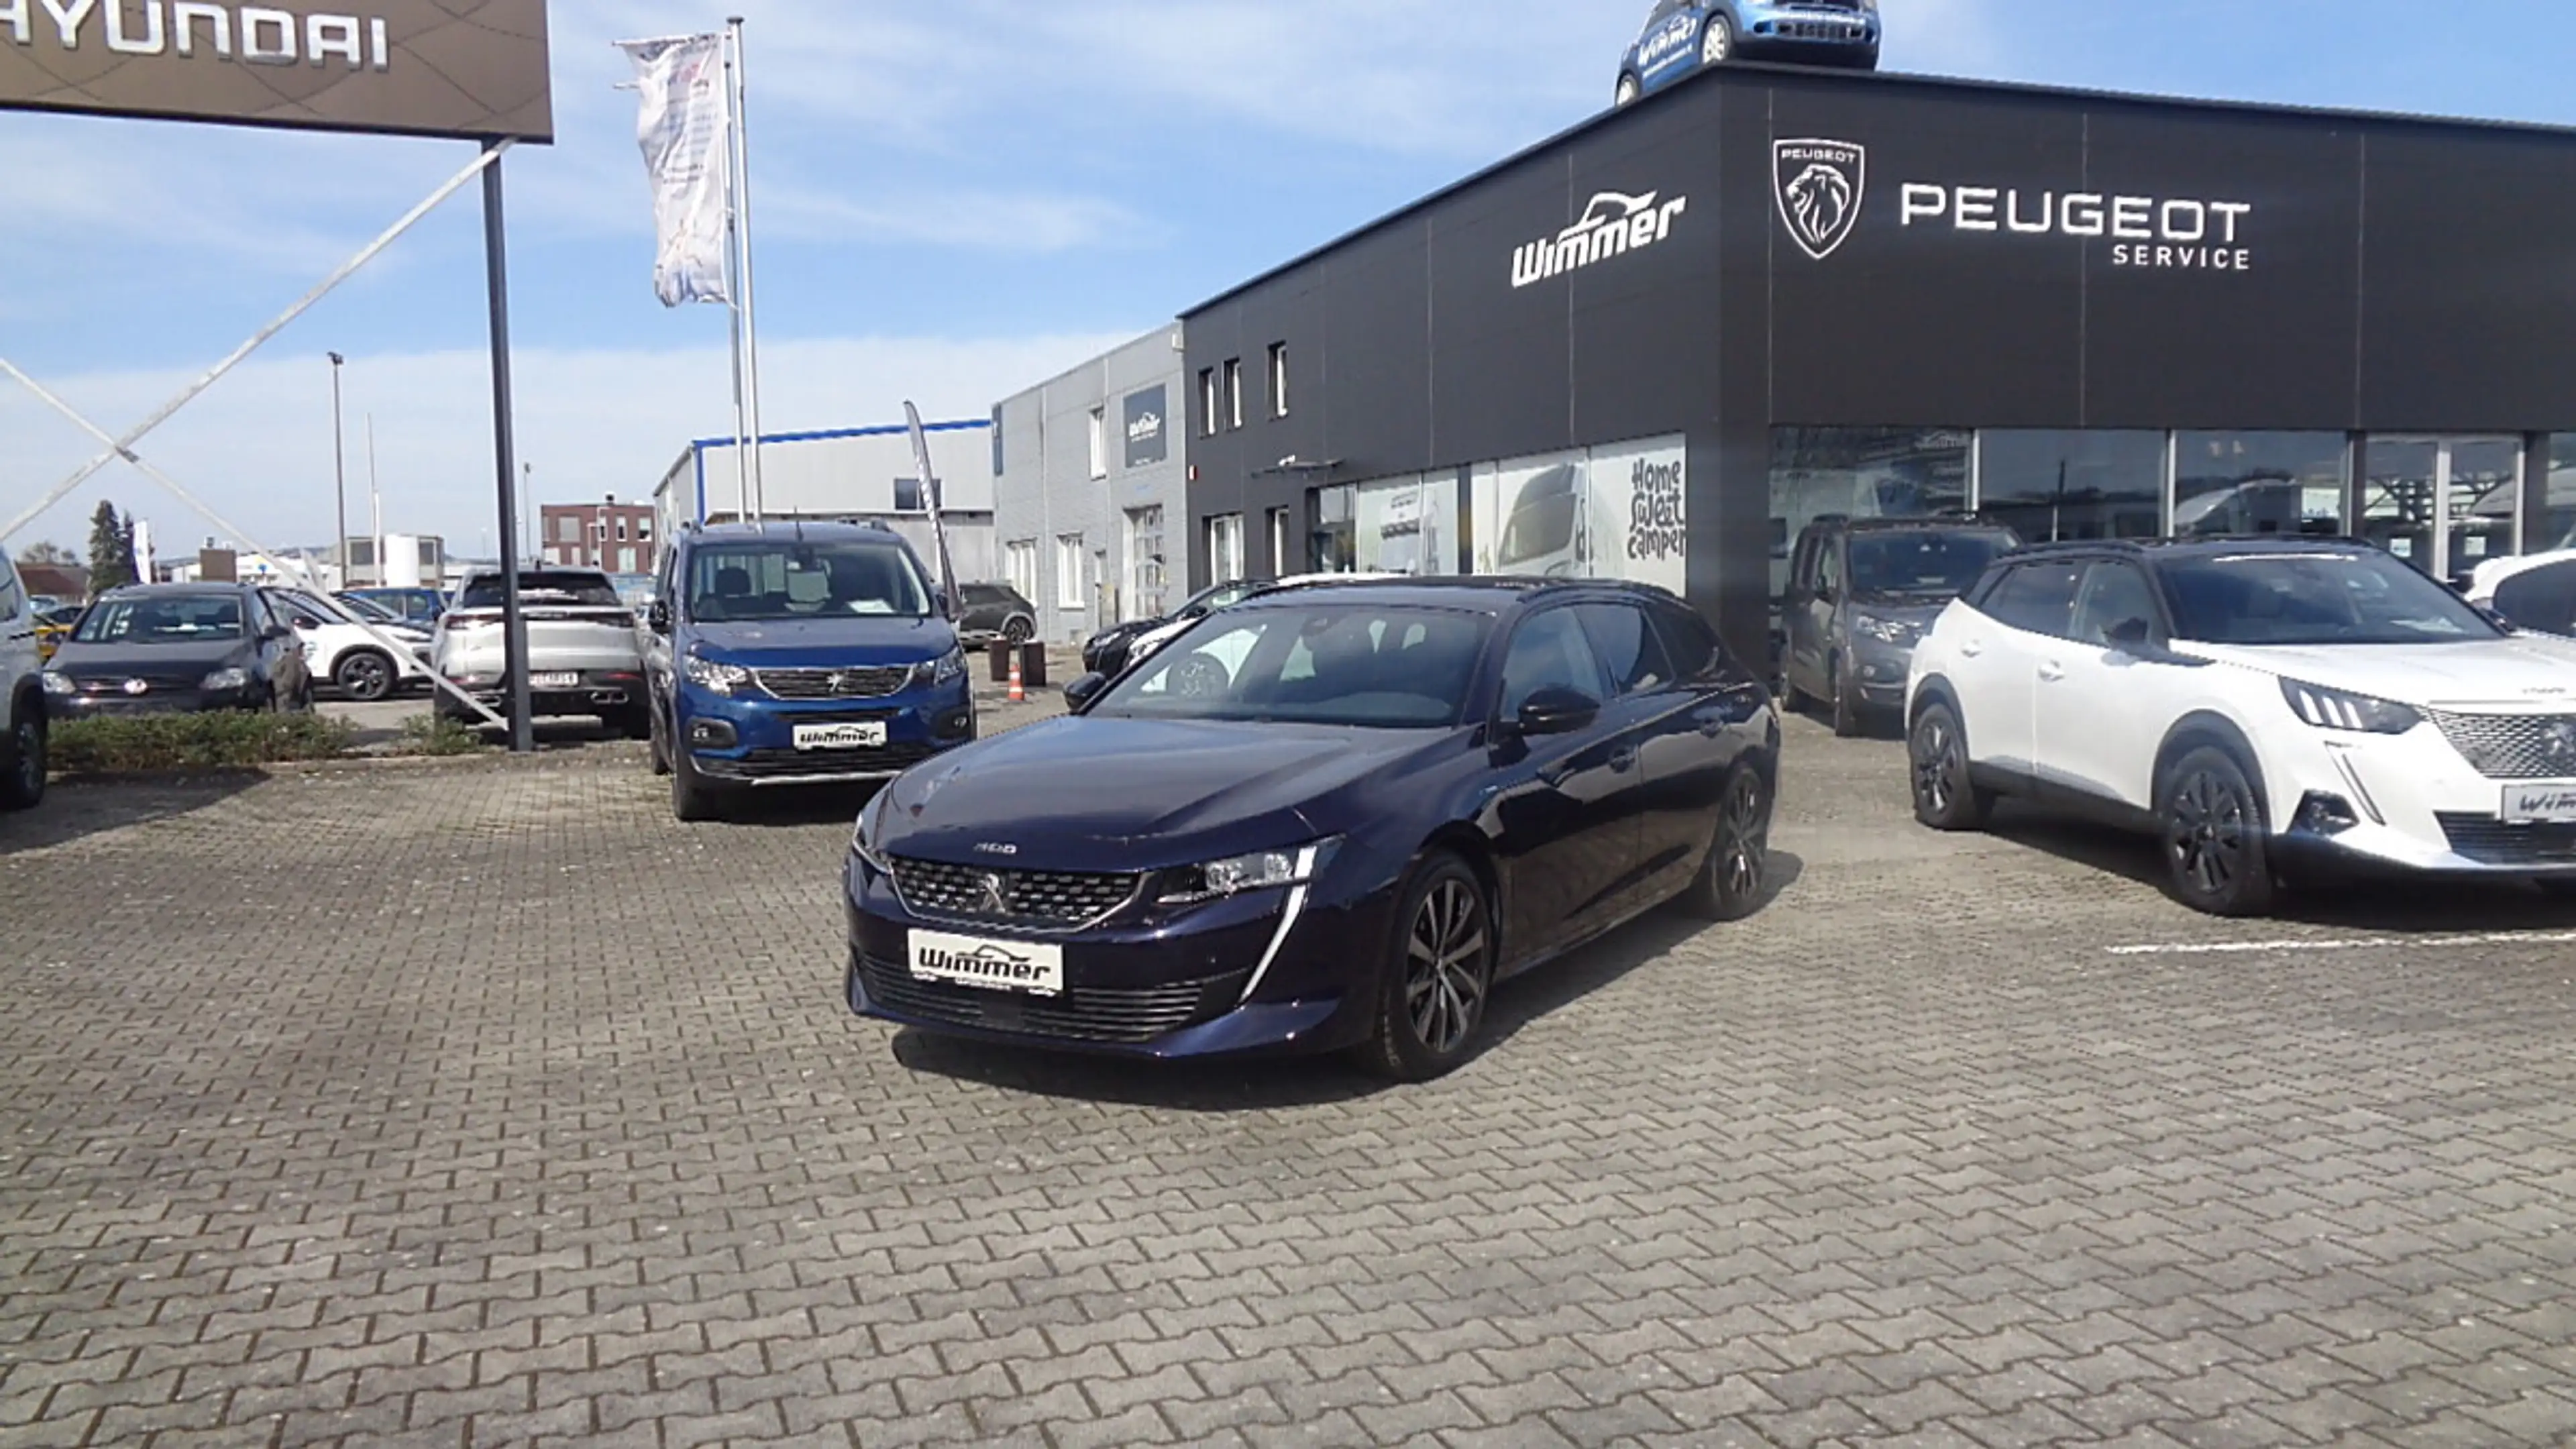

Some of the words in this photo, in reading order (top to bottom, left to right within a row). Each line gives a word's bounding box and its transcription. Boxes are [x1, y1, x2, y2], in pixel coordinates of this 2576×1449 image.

[1781, 148, 1856, 164] PEUGEOT
[1901, 182, 2251, 241] PEUGEOT
[1511, 195, 1686, 288] Wimmer
[2113, 244, 2249, 270] SERVICE
[1631, 458, 1681, 493] Home
[919, 947, 1051, 980] Wimmer
